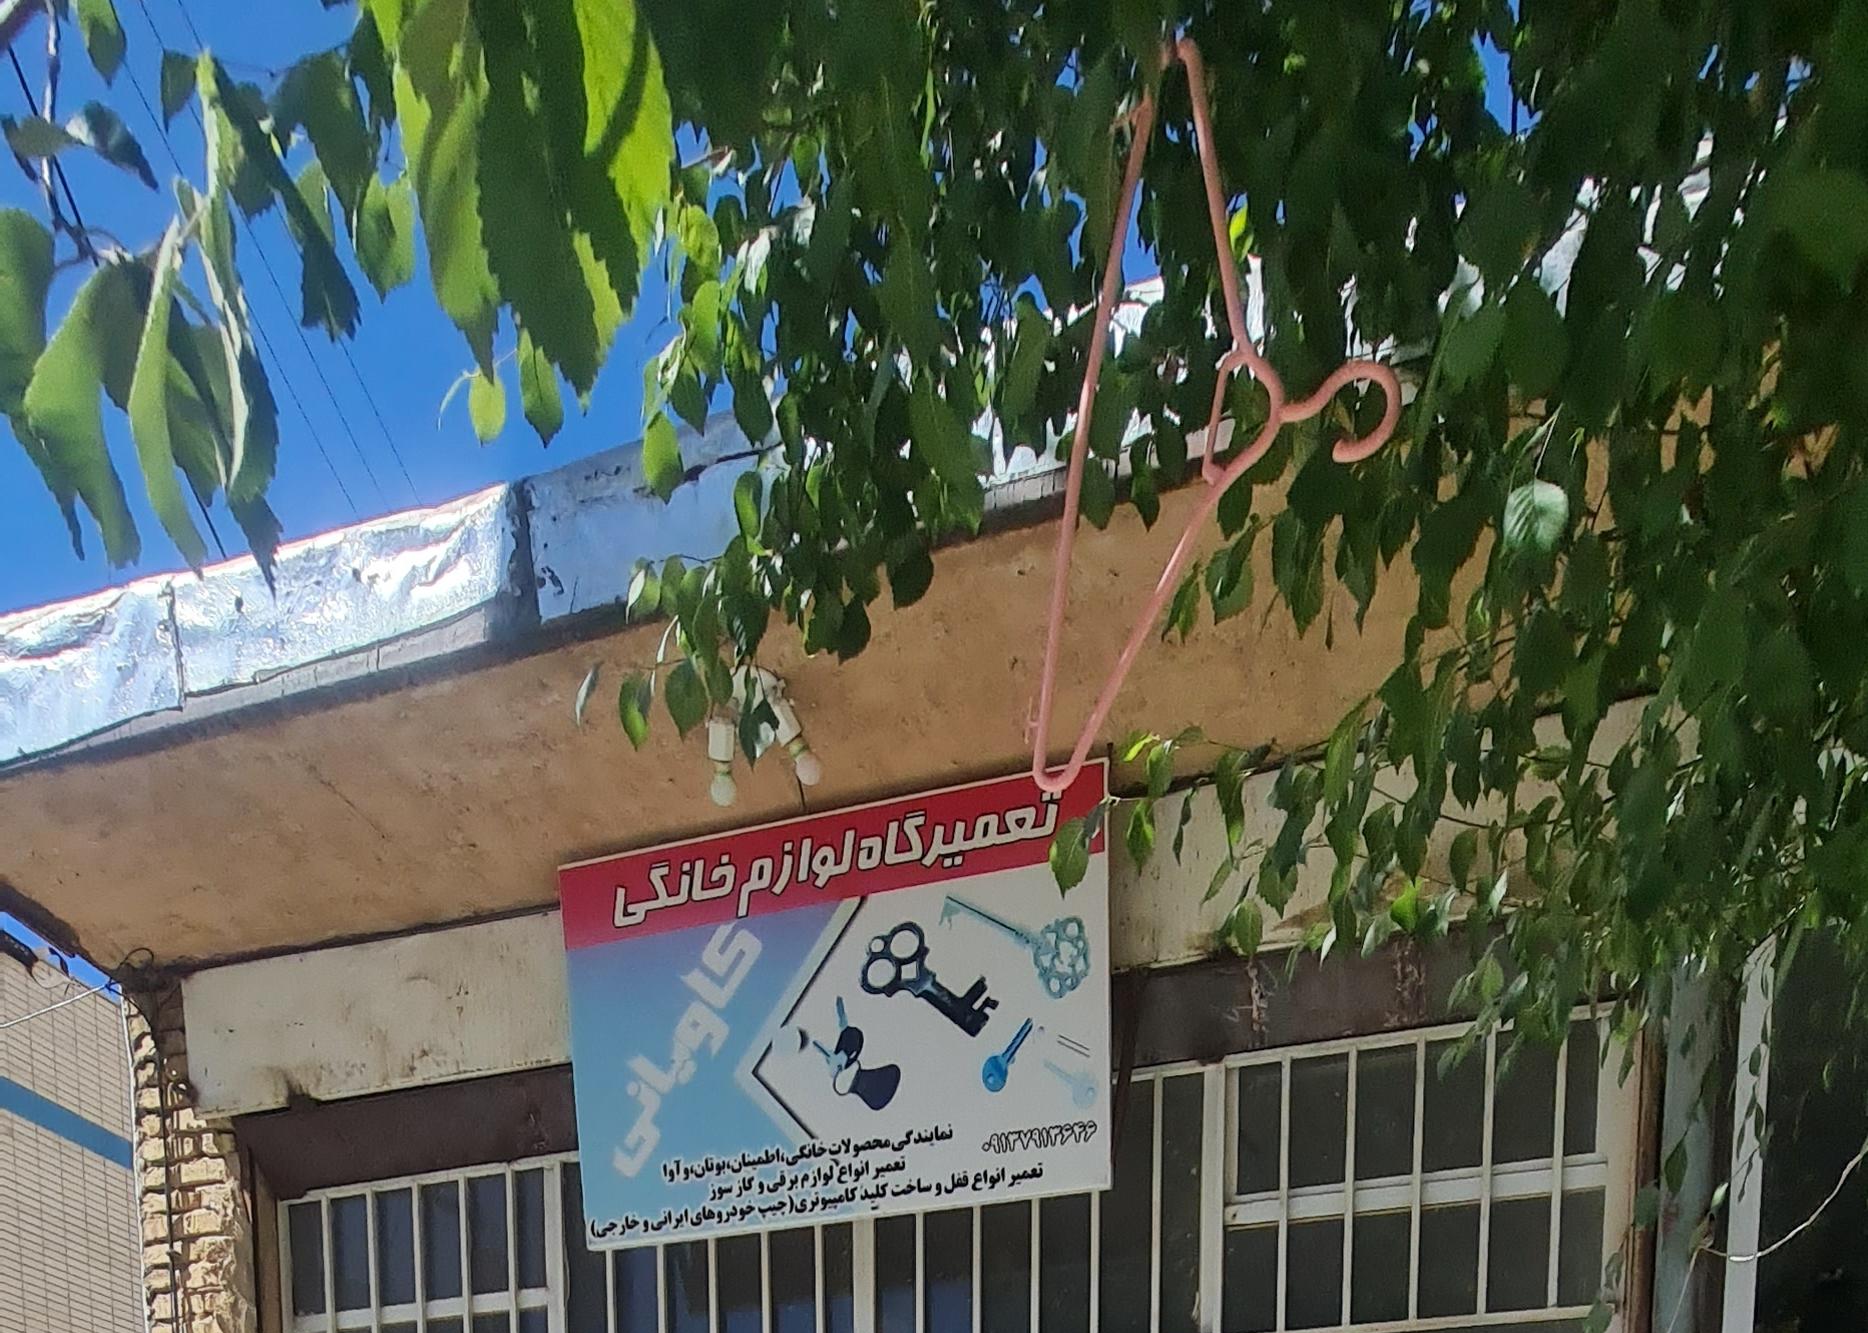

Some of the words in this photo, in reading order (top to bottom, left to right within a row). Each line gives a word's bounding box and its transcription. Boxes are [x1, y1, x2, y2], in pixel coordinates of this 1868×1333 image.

[857, 791, 1062, 869] تعمیرگاه
[736, 827, 858, 919] لوازم
[612, 853, 737, 928] خانگی
[612, 922, 763, 1178] کاویانی
[828, 1137, 891, 1158] محصولات
[891, 1123, 953, 1152] نمایندگی
[800, 1165, 834, 1188] لوازم
[836, 1160, 870, 1184] انواع
[872, 1155, 906, 1180] تعمیر
[971, 1166, 1006, 1192] انواع
[1007, 1162, 1044, 1188] تعمیر
[709, 1183, 733, 1201] سوز
[758, 1180, 765, 1195] و
[766, 1170, 799, 1193] برقی
[890, 1178, 933, 1197] ساخت
[934, 1182, 943, 1197] و
[944, 1170, 970, 1194] قفل
[642, 1219, 650, 1233] و
[650, 1208, 689, 1231] ایرانی
